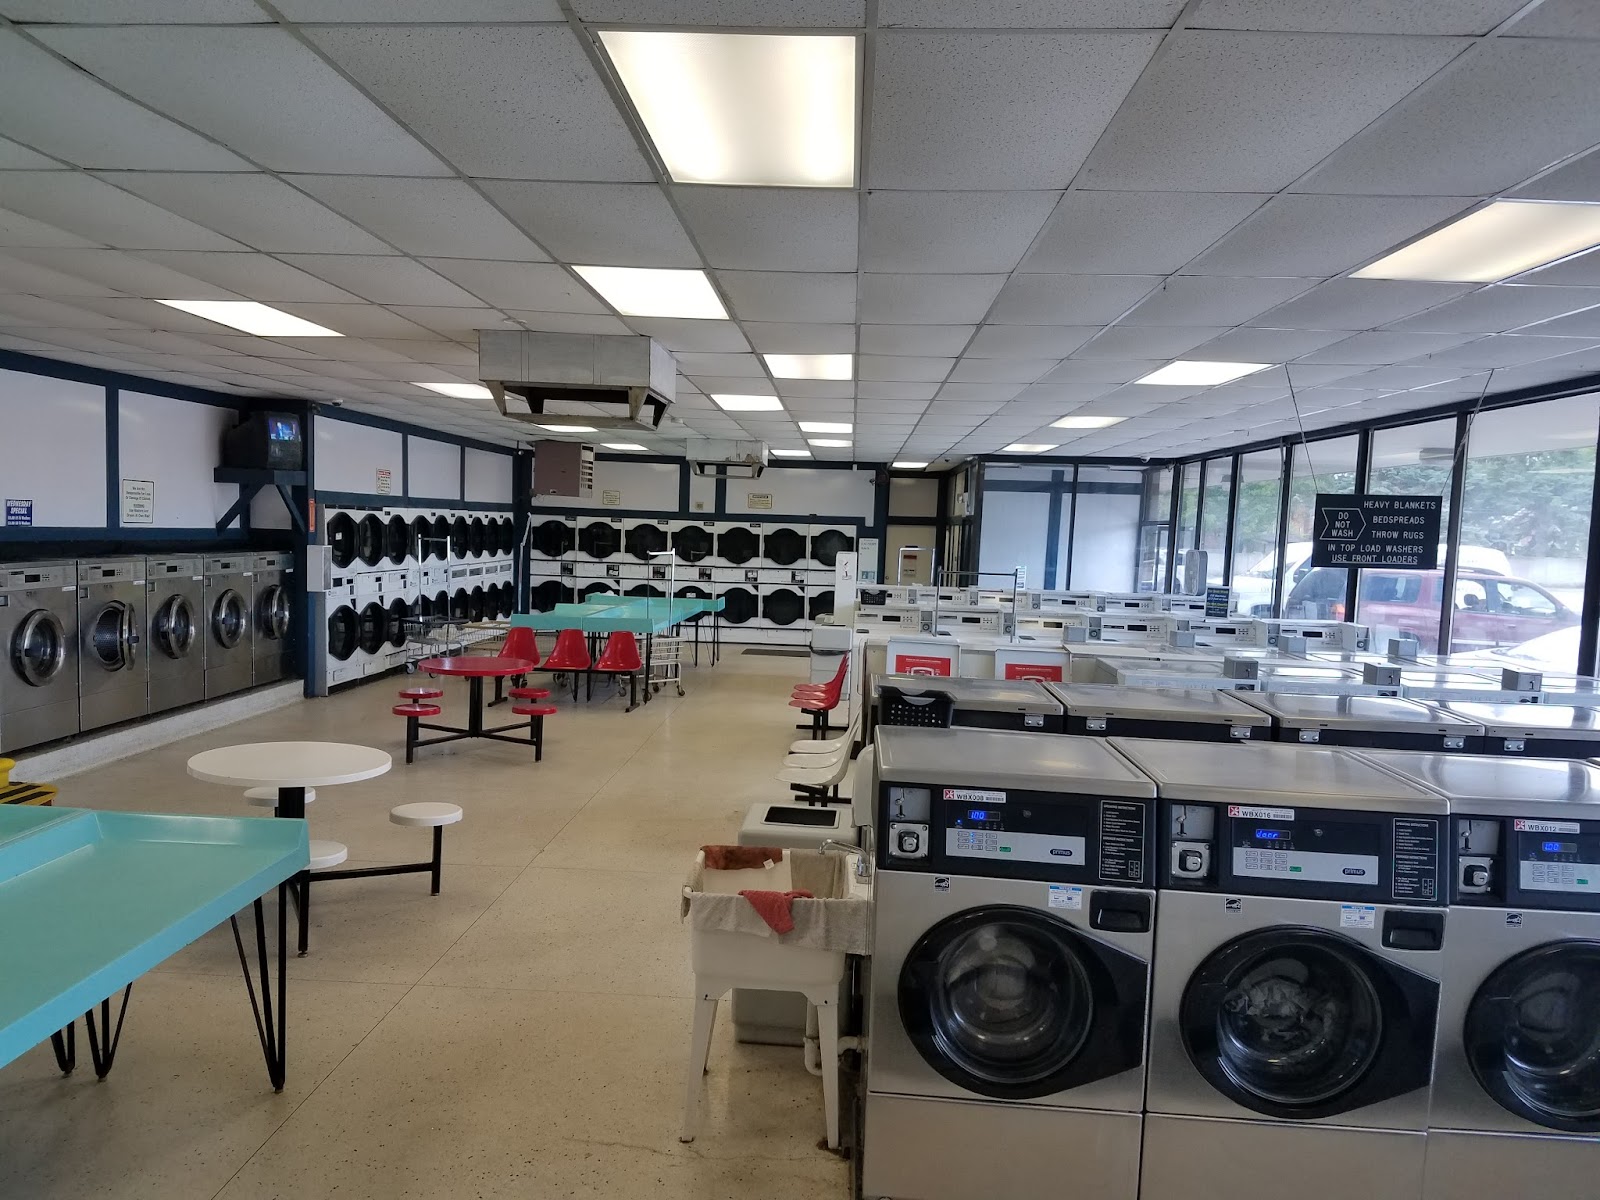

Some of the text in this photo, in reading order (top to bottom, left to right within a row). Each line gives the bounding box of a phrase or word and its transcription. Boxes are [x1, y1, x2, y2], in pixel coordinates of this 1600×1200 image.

[1363, 500, 1436, 510] HEAVY BLANKETS
[1338, 511, 1349, 520] DO
[1372, 515, 1425, 525] BEDSPREADS
[1334, 520, 1351, 529] NOT
[1331, 529, 1354, 538] WASH
[1371, 530, 1425, 540] THROW RUGS
[1327, 543, 1424, 554] IN TOP LOAD WASHERS
[1331, 554, 1418, 564] USE FRONT LOADERS
[1241, 810, 1271, 819] WBX016
[1527, 824, 1557, 832] WBX012
